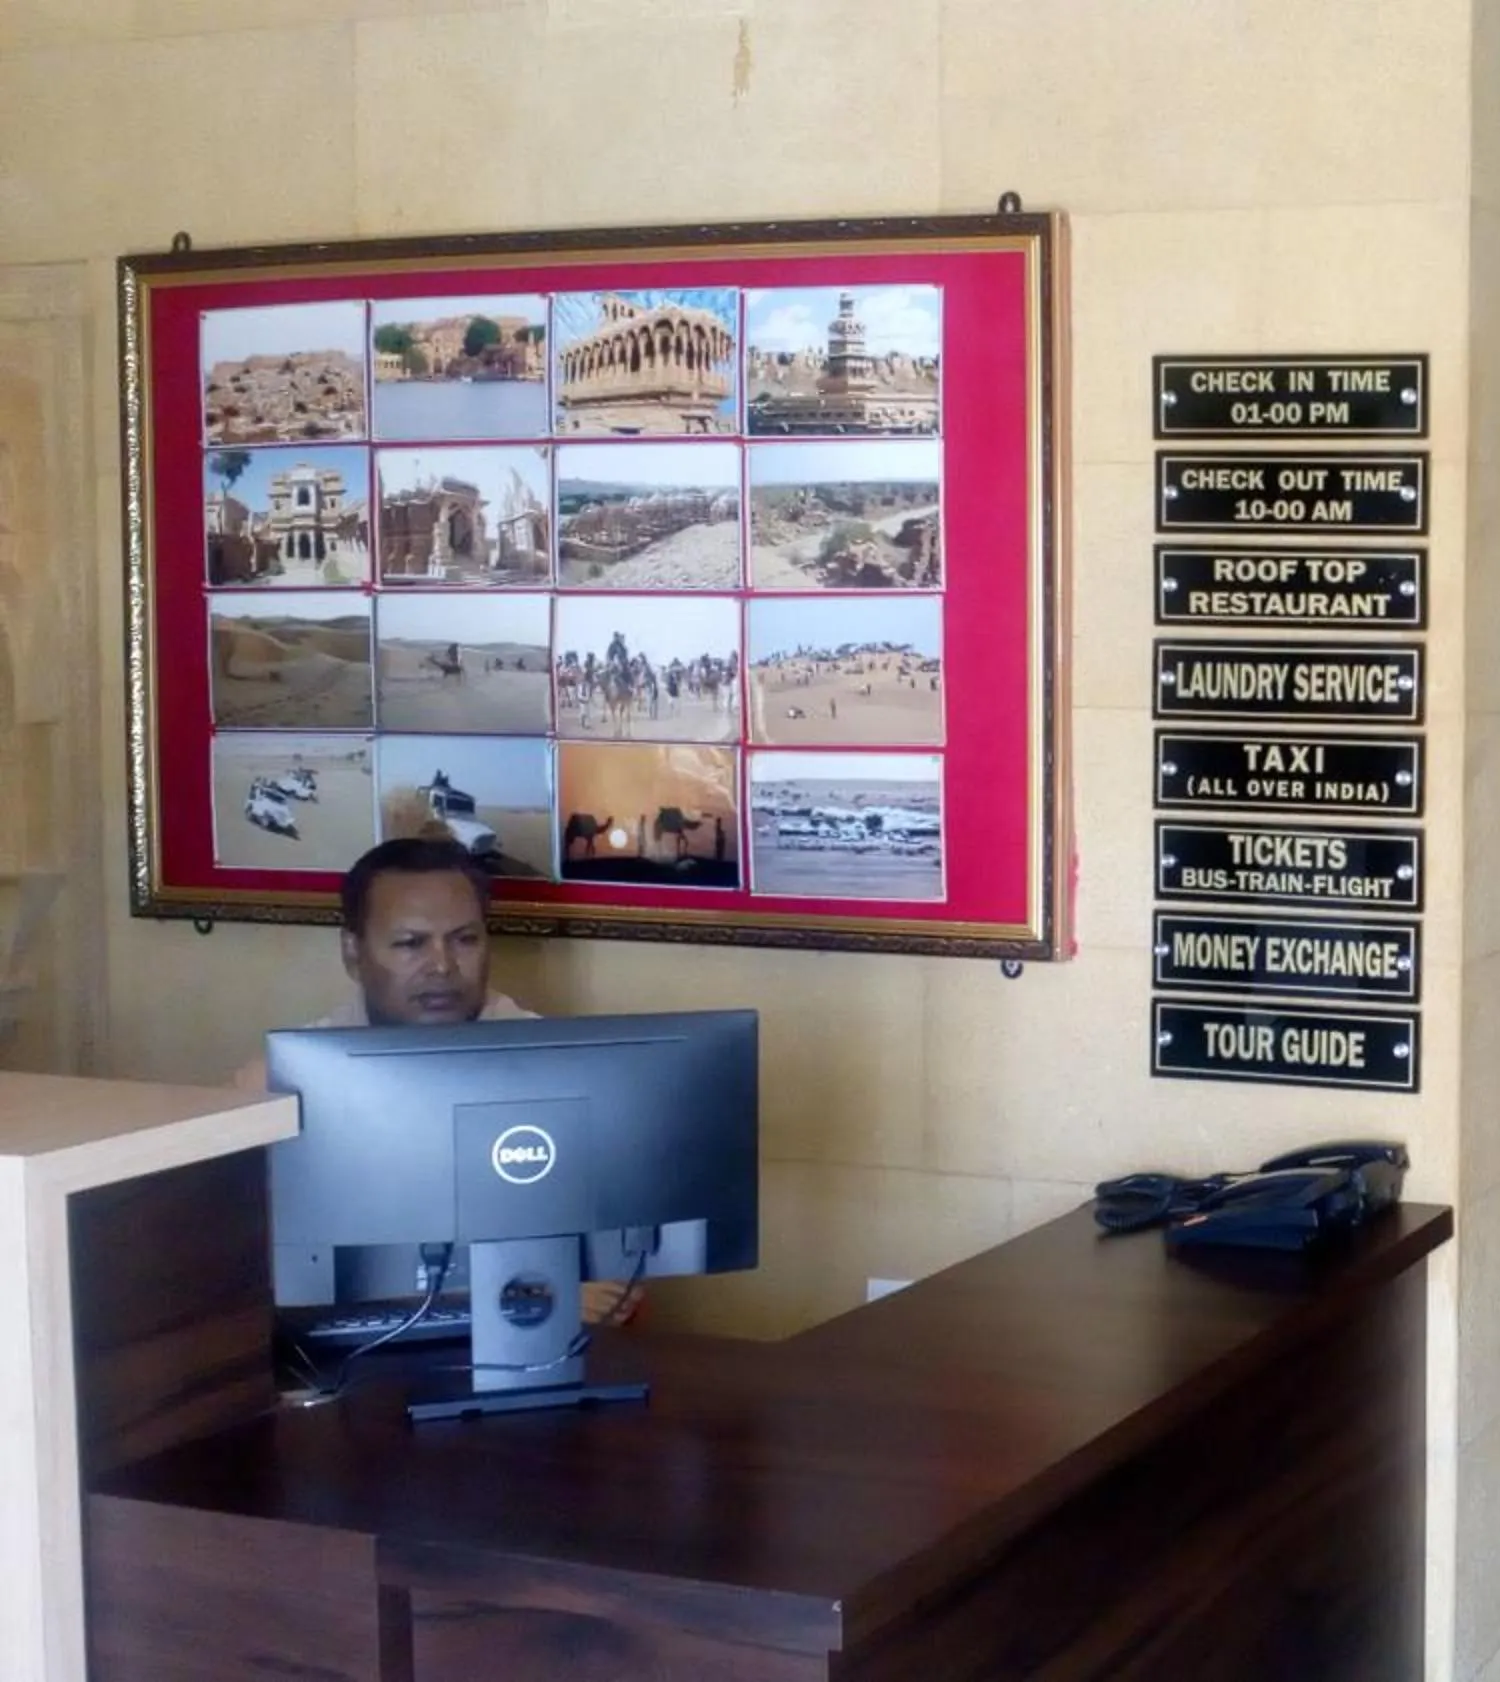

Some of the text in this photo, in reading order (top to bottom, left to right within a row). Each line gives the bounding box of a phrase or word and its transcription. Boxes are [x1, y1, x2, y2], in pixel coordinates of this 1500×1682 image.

[1190, 370, 1391, 393] CHECK IN TIME
[1231, 403, 1349, 424] 01-00 PM
[1181, 470, 1403, 491] CHECK OUT TIME
[1234, 501, 1353, 521] 10-00 AM
[1213, 560, 1367, 583] ROOF TOP
[1189, 592, 1392, 616] RESTAURANT
[1175, 662, 1399, 702] LAUNDRY SERVICE
[1243, 745, 1325, 773] TAXI
[1187, 776, 1389, 802] (ALL OVER INDIA)
[1228, 834, 1347, 869] TICKETS
[1181, 868, 1394, 898] BUS-TRAIN-FLIGHT
[1173, 932, 1399, 979] MONEY EXCHANGE
[1203, 1023, 1365, 1068] TOUR GUIDE
[500, 1146, 548, 1164] DELL
